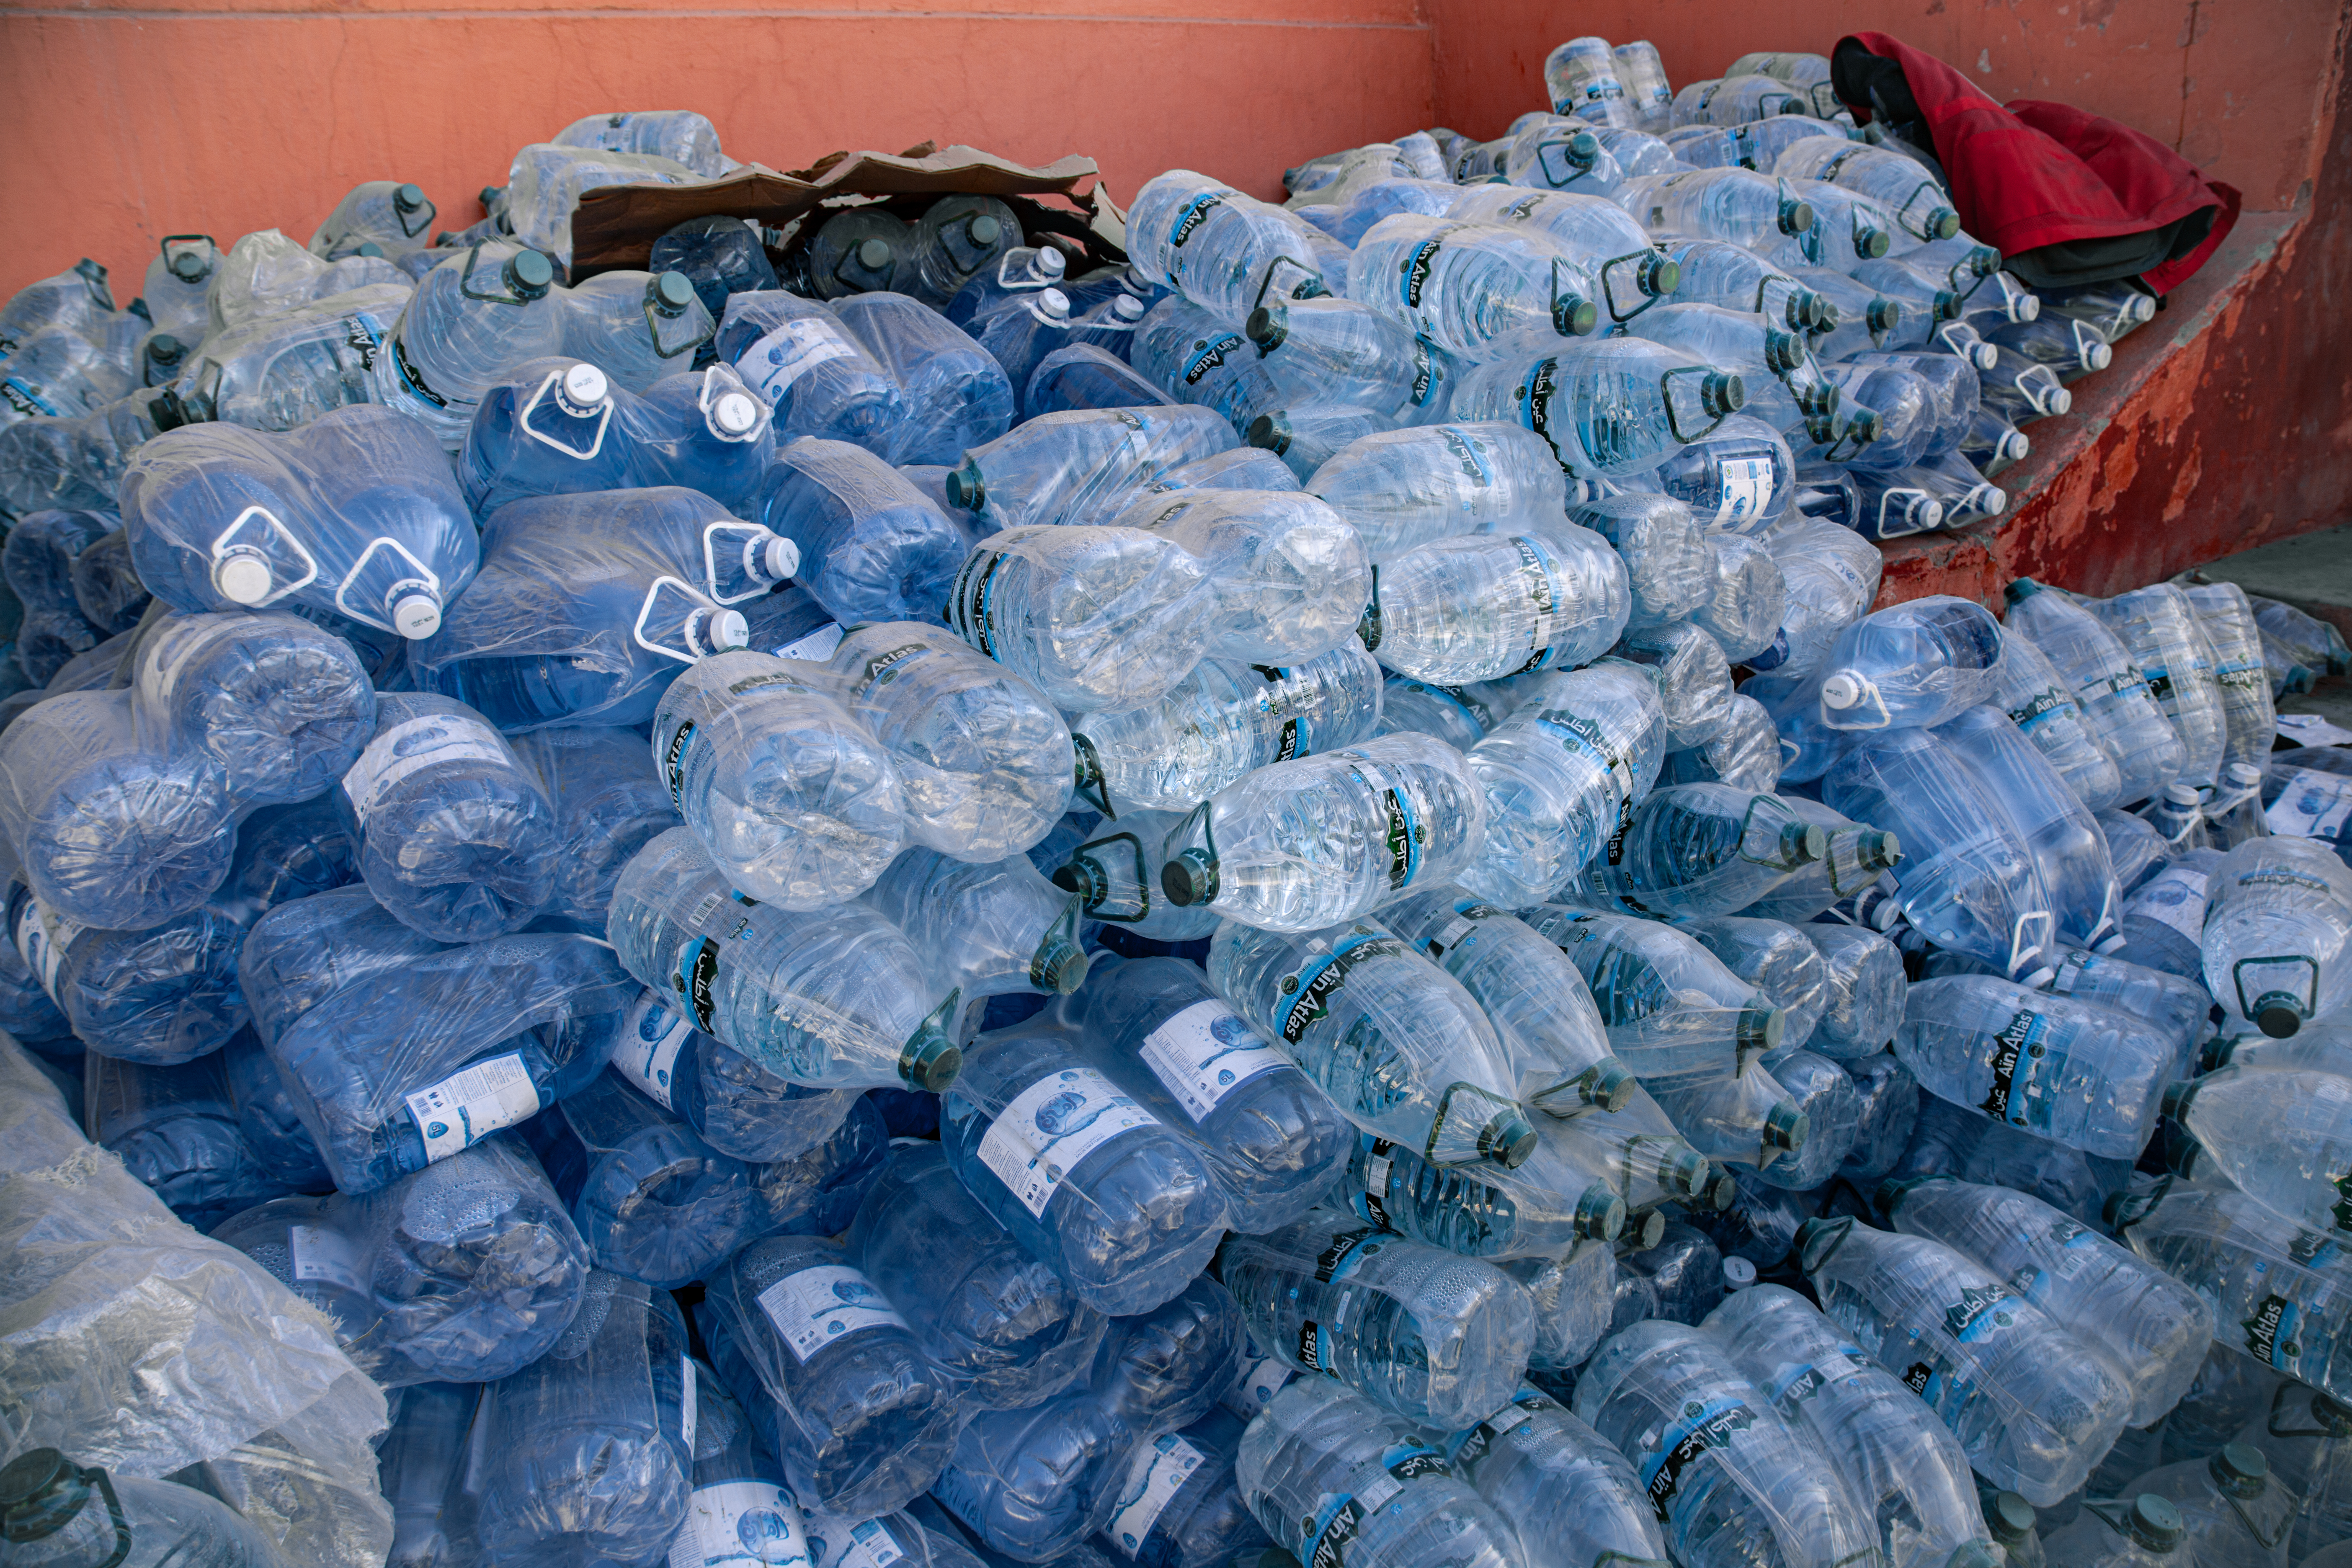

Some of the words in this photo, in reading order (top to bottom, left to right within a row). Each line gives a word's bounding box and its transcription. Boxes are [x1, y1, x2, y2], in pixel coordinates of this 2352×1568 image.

[1197, 197, 1219, 208] Aïn
[1177, 208, 1202, 241] Atlas
[1418, 241, 1439, 261] Aïn
[1410, 263, 1427, 302] Atlas
[349, 317, 374, 345] Atlas
[1216, 337, 1238, 351] Aïn
[396, 347, 417, 382] أطلس
[1191, 350, 1220, 379] Atlas
[1416, 377, 1429, 400] Aïn
[1535, 364, 1549, 394] أطلس
[416, 384, 440, 402] عين
[1532, 398, 1545, 424] عين
[1452, 443, 1483, 477] أطلس
[1156, 506, 1181, 524] las
[1516, 542, 1544, 574] Atlas
[979, 578, 989, 610] عين
[974, 614, 994, 660] أطلس
[872, 646, 918, 677] Atlas
[2117, 676, 2134, 691] Aïn
[2221, 671, 2251, 684] Atlas
[1467, 704, 1489, 728] Aïn
[2035, 698, 2055, 715] Aïn
[1550, 716, 1594, 736] أطلس
[669, 728, 689, 778] Atlas
[680, 744, 691, 767] NATURALITÉ
[1281, 728, 1297, 762] tlas
[1589, 736, 1615, 759] عين
[1387, 797, 1405, 831] عين
[1393, 835, 1408, 879] أطلس
[730, 927, 742, 939] Atlas
[745, 931, 753, 939] 13
[1351, 940, 1376, 960] عين
[696, 953, 709, 1006] أطلس
[1298, 963, 1310, 977] FORCE
[1308, 962, 1341, 993] Aïn
[1315, 965, 1323, 975] EAU
[1296, 974, 1315, 996] MINÉRALE
[694, 1002, 710, 1032] عين
[1274, 995, 1285, 1015] NATURALITÉ
[1282, 996, 1297, 1023] NATURELLE
[1290, 990, 1320, 1037] Atlas
[2003, 1014, 2032, 1052] Atlas
[1998, 1048, 2017, 1079] Aïn
[661, 1074, 667, 1085] 5L
[1040, 1093, 1078, 1133] أمان
[1994, 1089, 2006, 1112] عين
[433, 1124, 444, 1137] 5L
[1085, 1141, 1094, 1150] TABLE
[1093, 1134, 1105, 1143] PURIFIÉE
[2061, 1221, 2085, 1240] طلس
[1326, 1236, 1356, 1270] أطلس
[2302, 1234, 2324, 1257] طلس
[1986, 1286, 2006, 1302] عين
[1955, 1290, 1986, 1328] أطلس
[830, 1323, 844, 1332] 5L
[2251, 1303, 2281, 1345] Atlas
[1303, 1331, 1323, 1372] Atlas
[1260, 1389, 1269, 1400] 5L
[1787, 1373, 1814, 1399] Aïn
[1906, 1370, 1927, 1394] las
[1460, 1429, 1485, 1461] Aïn
[1678, 1431, 1705, 1460] عين
[1707, 1408, 1743, 1442] أطلس
[1400, 1457, 1422, 1476] عين
[1652, 1464, 1673, 1495] Aïn
[1315, 1503, 1326, 1519] FORCE
[1329, 1504, 1354, 1539] Aïn
[743, 1512, 781, 1546] أمان
[1127, 1536, 1135, 1546] 5L
[1314, 1536, 1337, 1568] Atla
